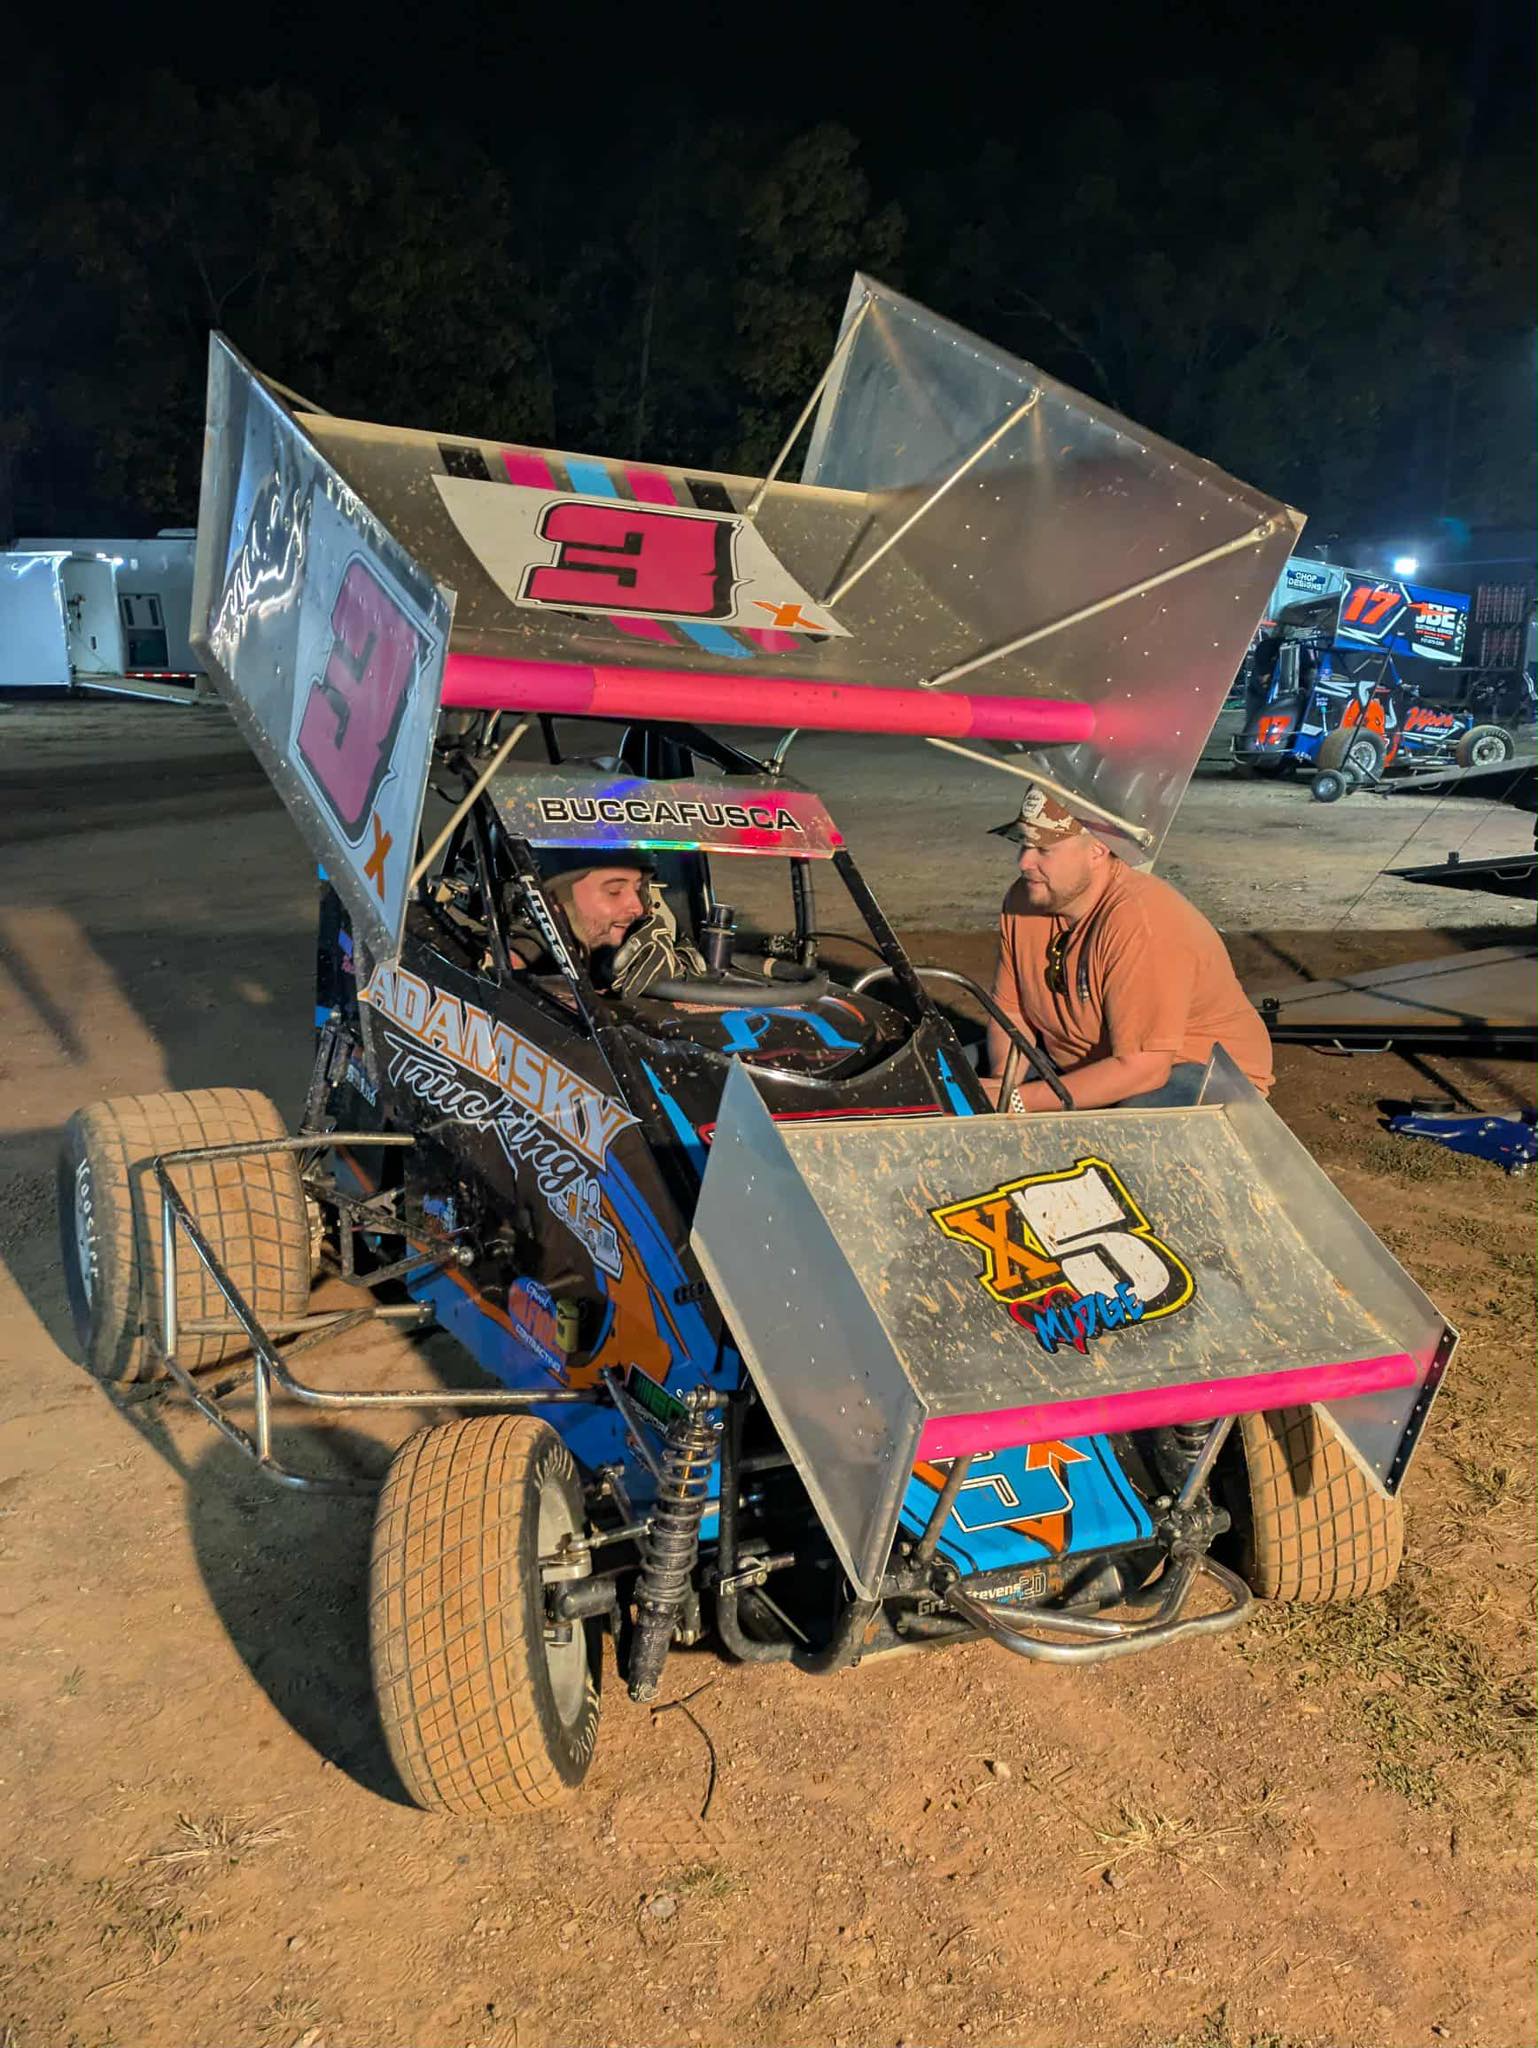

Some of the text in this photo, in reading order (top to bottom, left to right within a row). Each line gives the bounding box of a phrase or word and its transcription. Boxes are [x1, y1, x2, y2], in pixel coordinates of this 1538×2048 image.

[1288, 578, 1322, 591] DESIGNS
[1295, 572, 1317, 582] CHOP
[1344, 586, 1402, 625] 17
[1257, 714, 1292, 745] 17
[538, 797, 804, 833] BUCCAFUSCA
[358, 958, 643, 1172] ADAMSKY
[384, 1031, 590, 1198] Trucking
[1033, 1282, 1146, 1354] MIDGE
